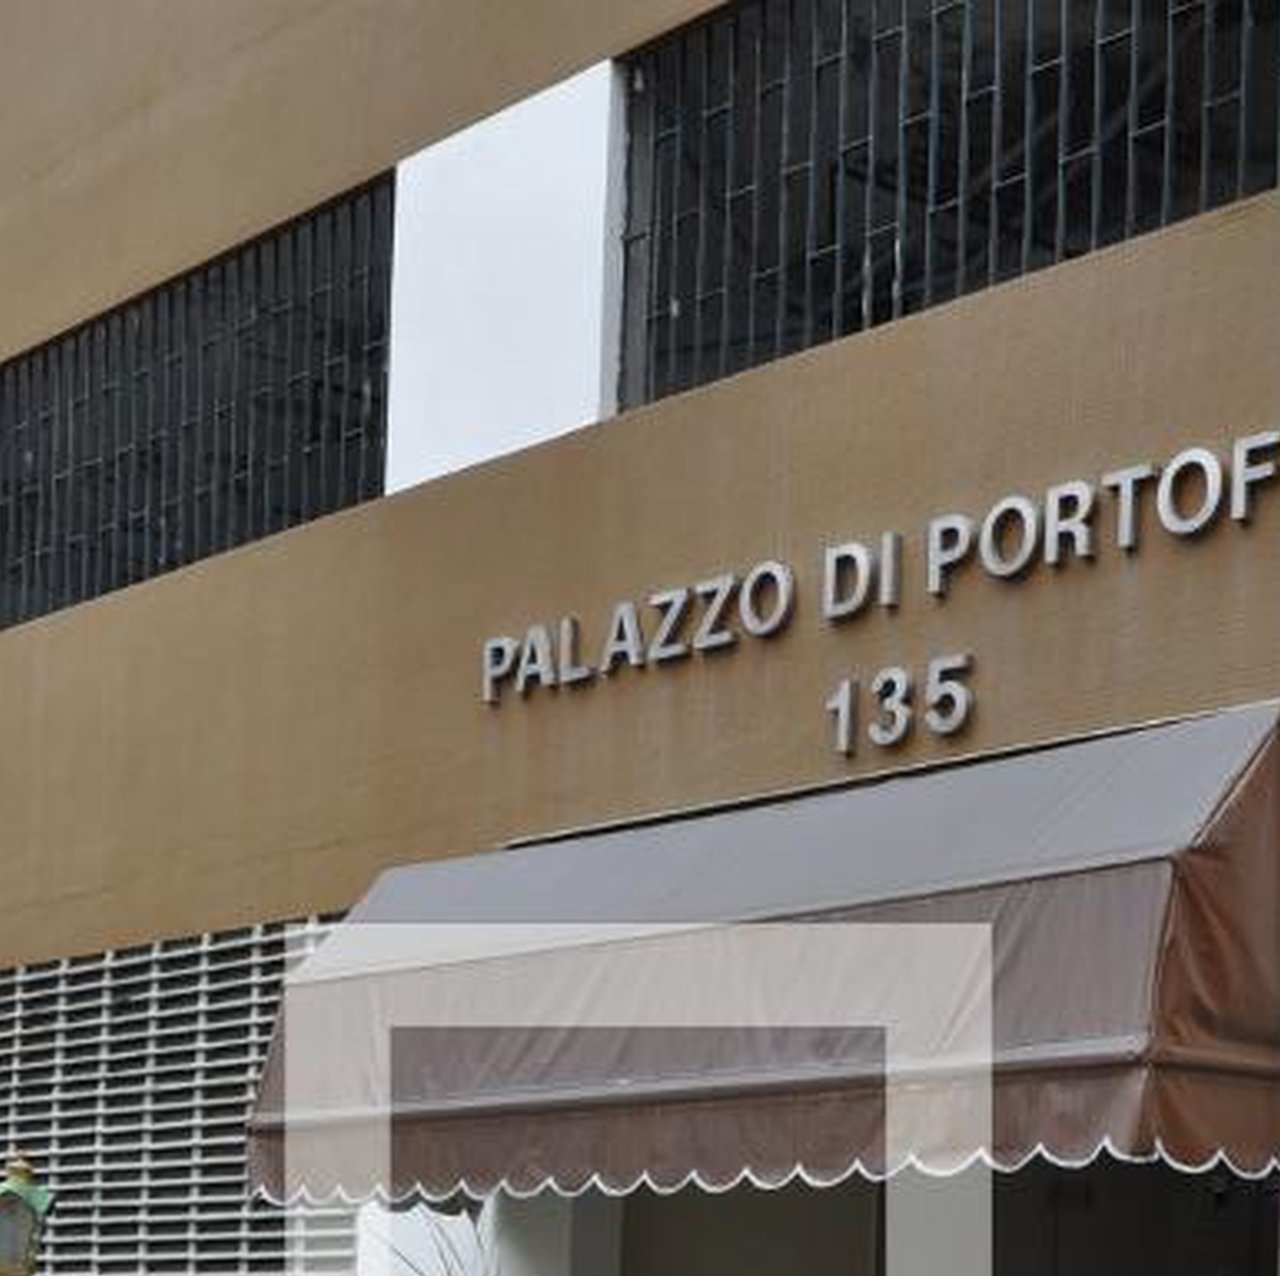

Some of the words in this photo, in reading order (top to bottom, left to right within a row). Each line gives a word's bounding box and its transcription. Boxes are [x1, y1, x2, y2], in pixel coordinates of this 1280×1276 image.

[482, 559, 796, 702] PALAZZO
[821, 530, 904, 622] DI
[825, 653, 974, 754] 135
